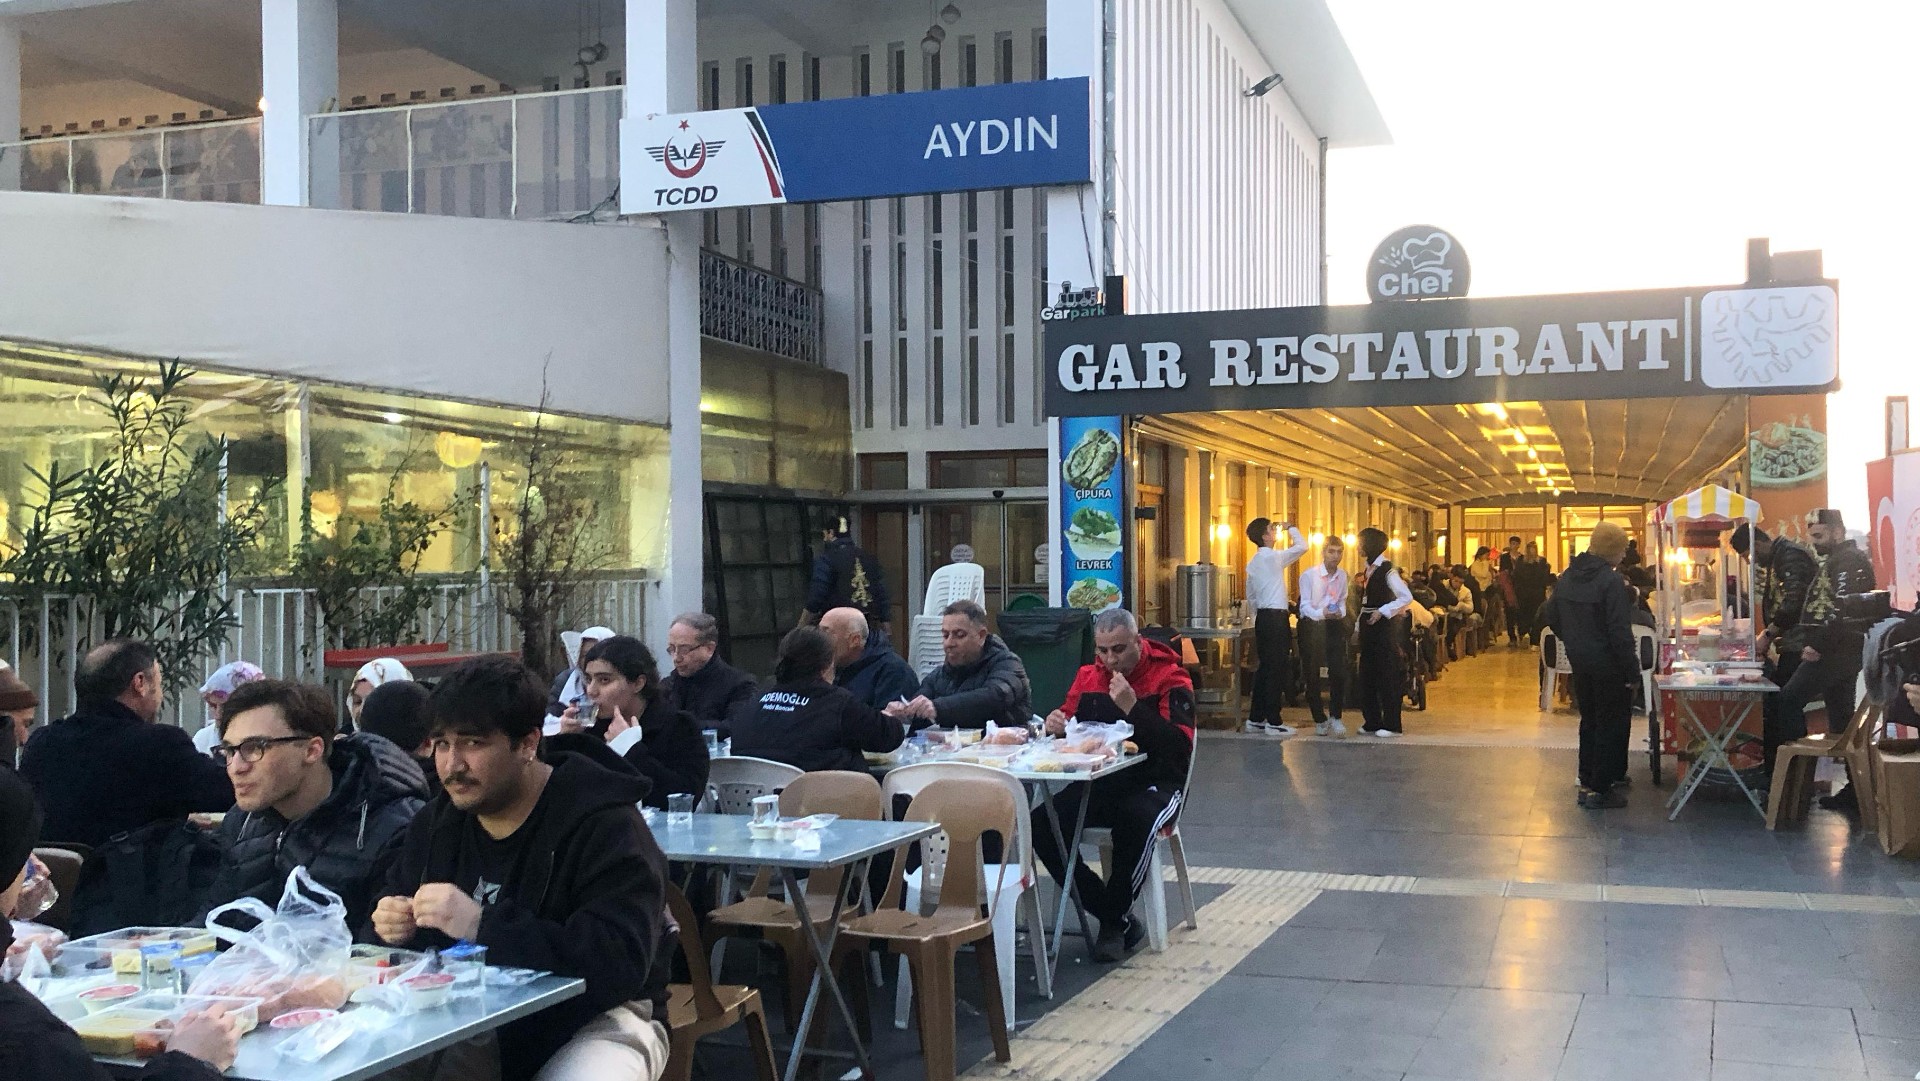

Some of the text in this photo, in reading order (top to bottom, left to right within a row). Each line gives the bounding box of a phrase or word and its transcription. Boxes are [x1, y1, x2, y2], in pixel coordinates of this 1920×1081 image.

[923, 114, 1059, 160] AYDIN
[654, 185, 719, 206] TCDD
[1378, 268, 1454, 297] Chef
[1040, 304, 1106, 322] Garpark
[1058, 317, 1678, 393] GAR RESTAURANT
[1075, 488, 1112, 500] ÇİPURA
[1076, 560, 1112, 570] LEVREK
[759, 692, 810, 706] ADEMOĞLU
